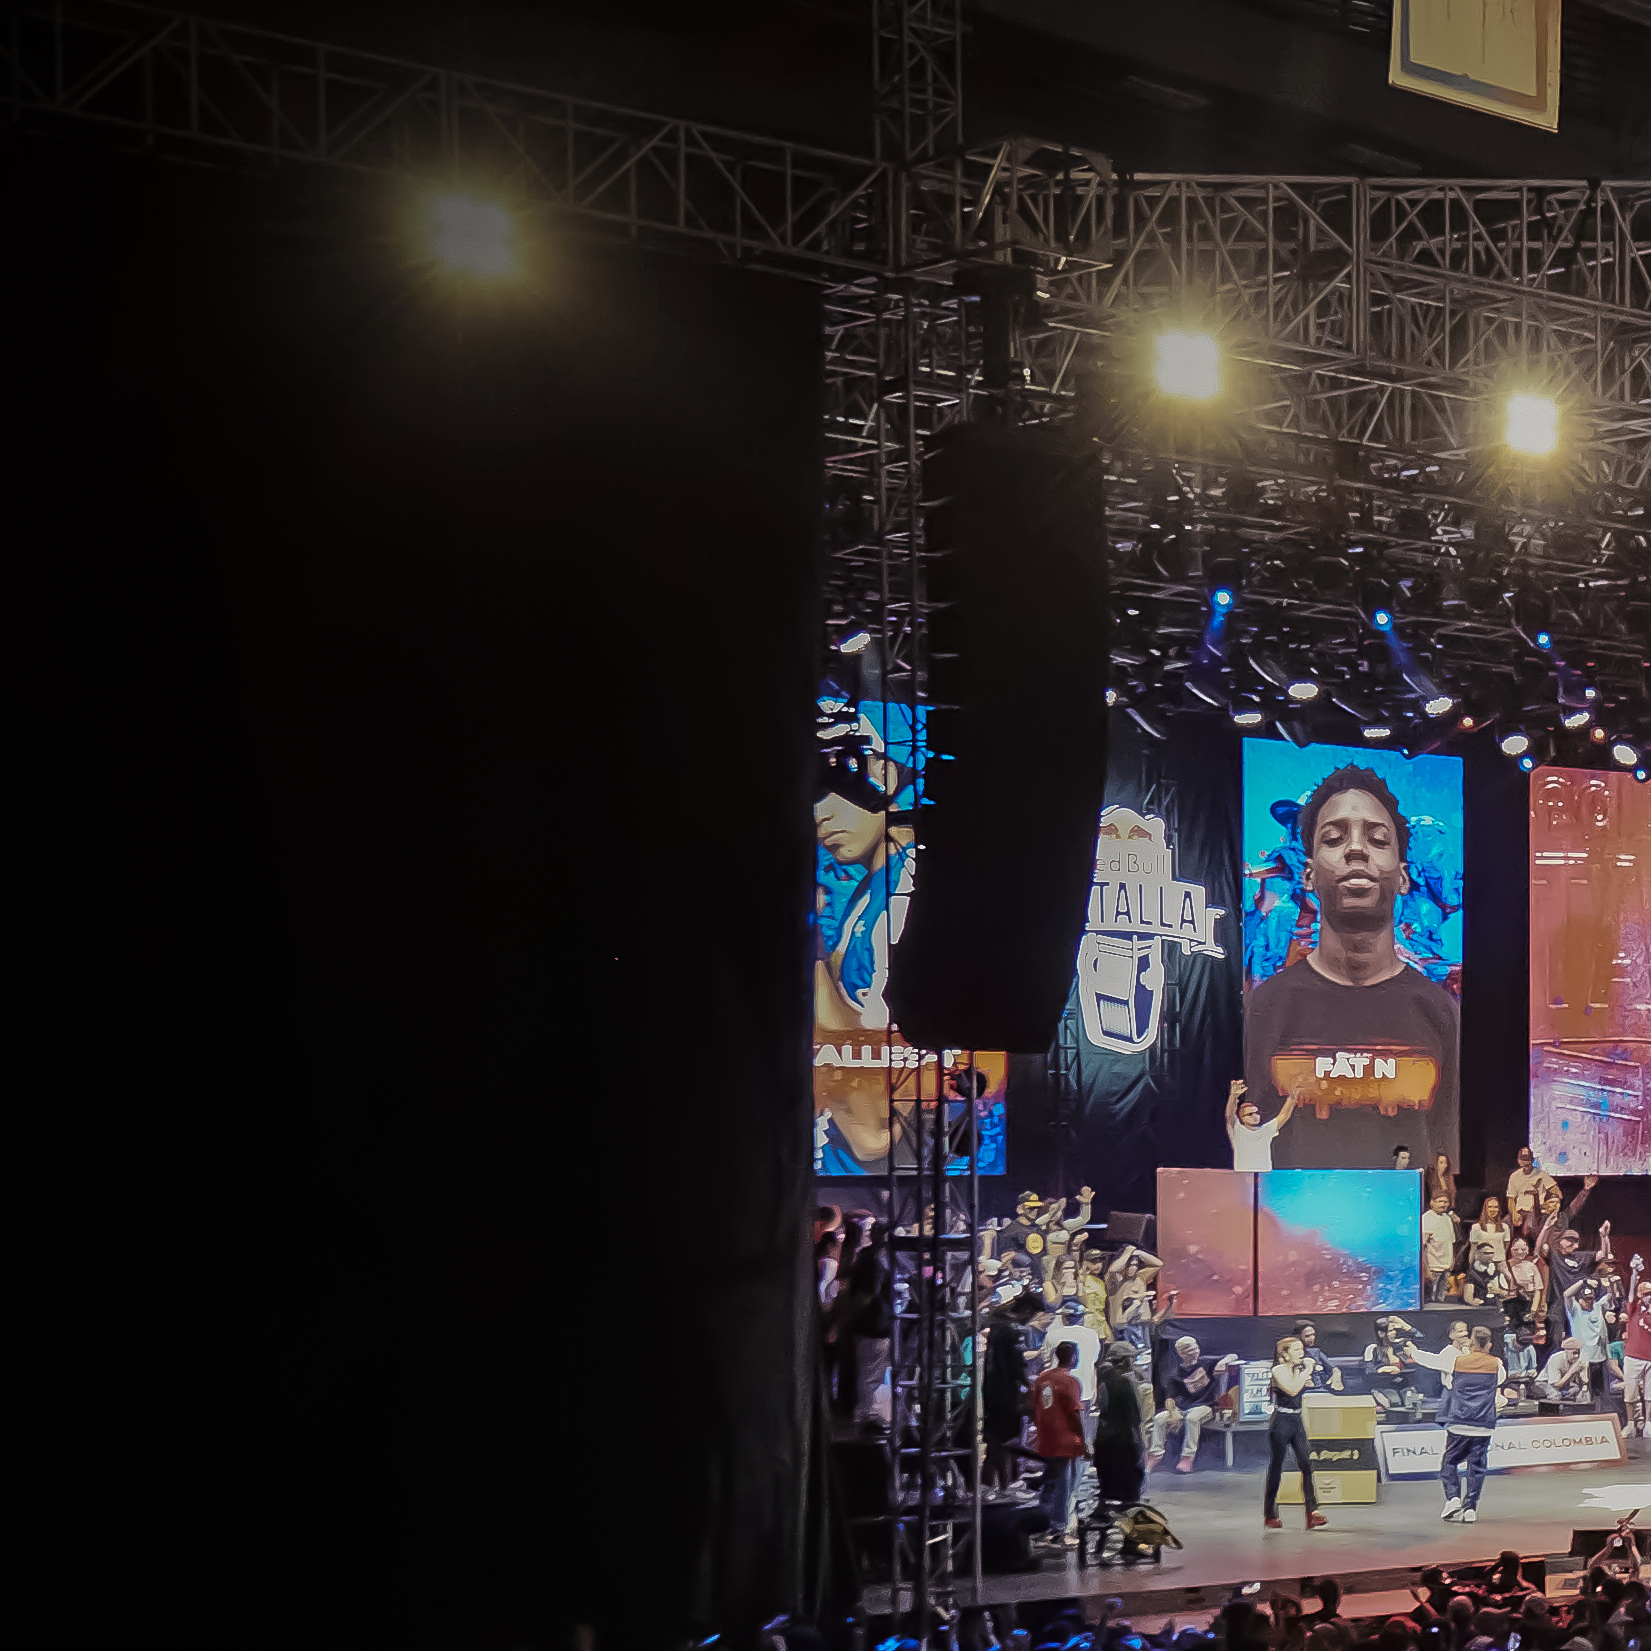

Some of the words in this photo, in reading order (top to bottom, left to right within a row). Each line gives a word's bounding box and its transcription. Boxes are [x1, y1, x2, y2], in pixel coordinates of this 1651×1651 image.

[1127, 853, 1166, 875] Bull
[1093, 881, 1198, 933] TALLA
[1315, 1056, 1370, 1078] FAT
[1374, 1057, 1396, 1079] N
[1392, 1446, 1439, 1457] FINAL
[1531, 1435, 1611, 1450] COLOMBIA
